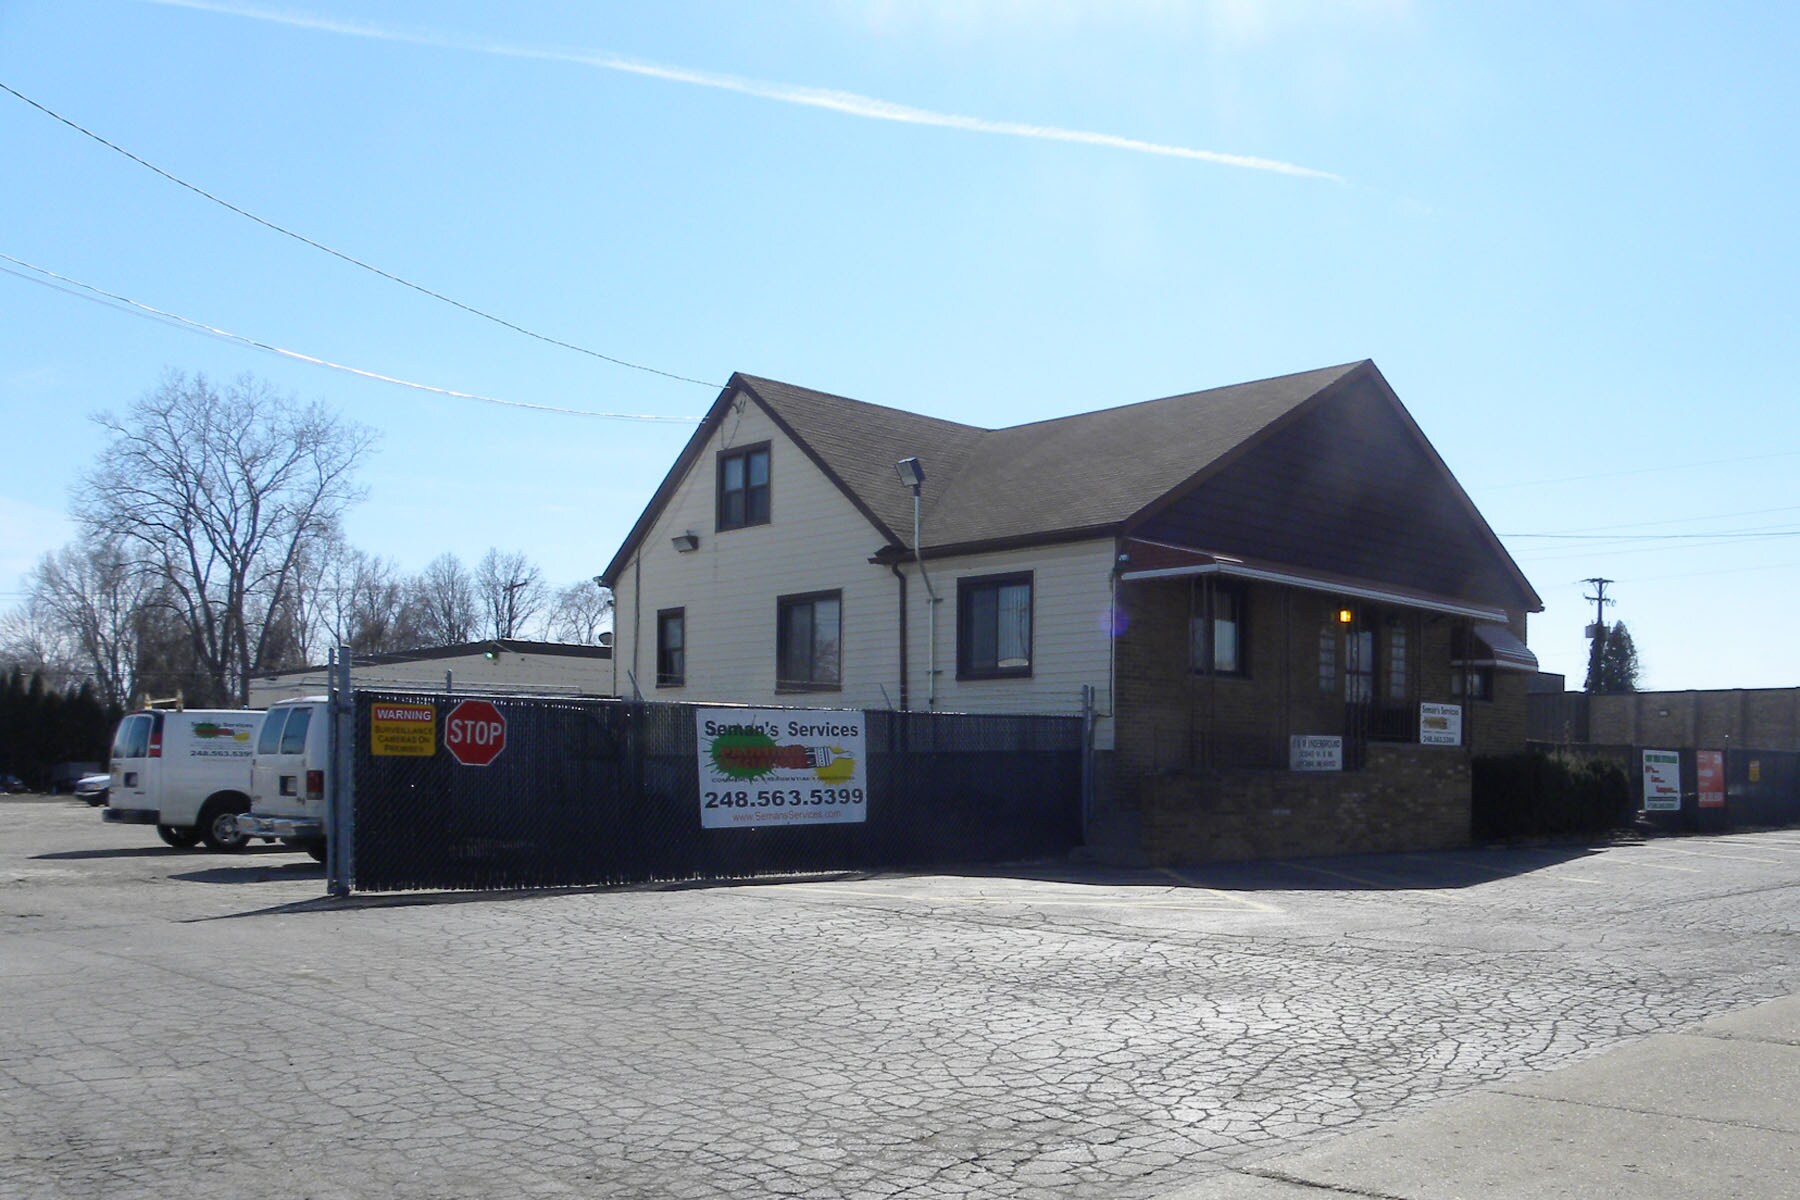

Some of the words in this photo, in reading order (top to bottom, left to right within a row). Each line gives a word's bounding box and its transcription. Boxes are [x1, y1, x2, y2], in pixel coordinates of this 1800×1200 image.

[376, 708, 432, 720] WARNING
[449, 719, 502, 745] STOP
[704, 720, 779, 737] Seman's
[788, 721, 859, 737] Services
[704, 788, 864, 809] 248.563.5399
[731, 809, 842, 822] www.SemansServices.com
